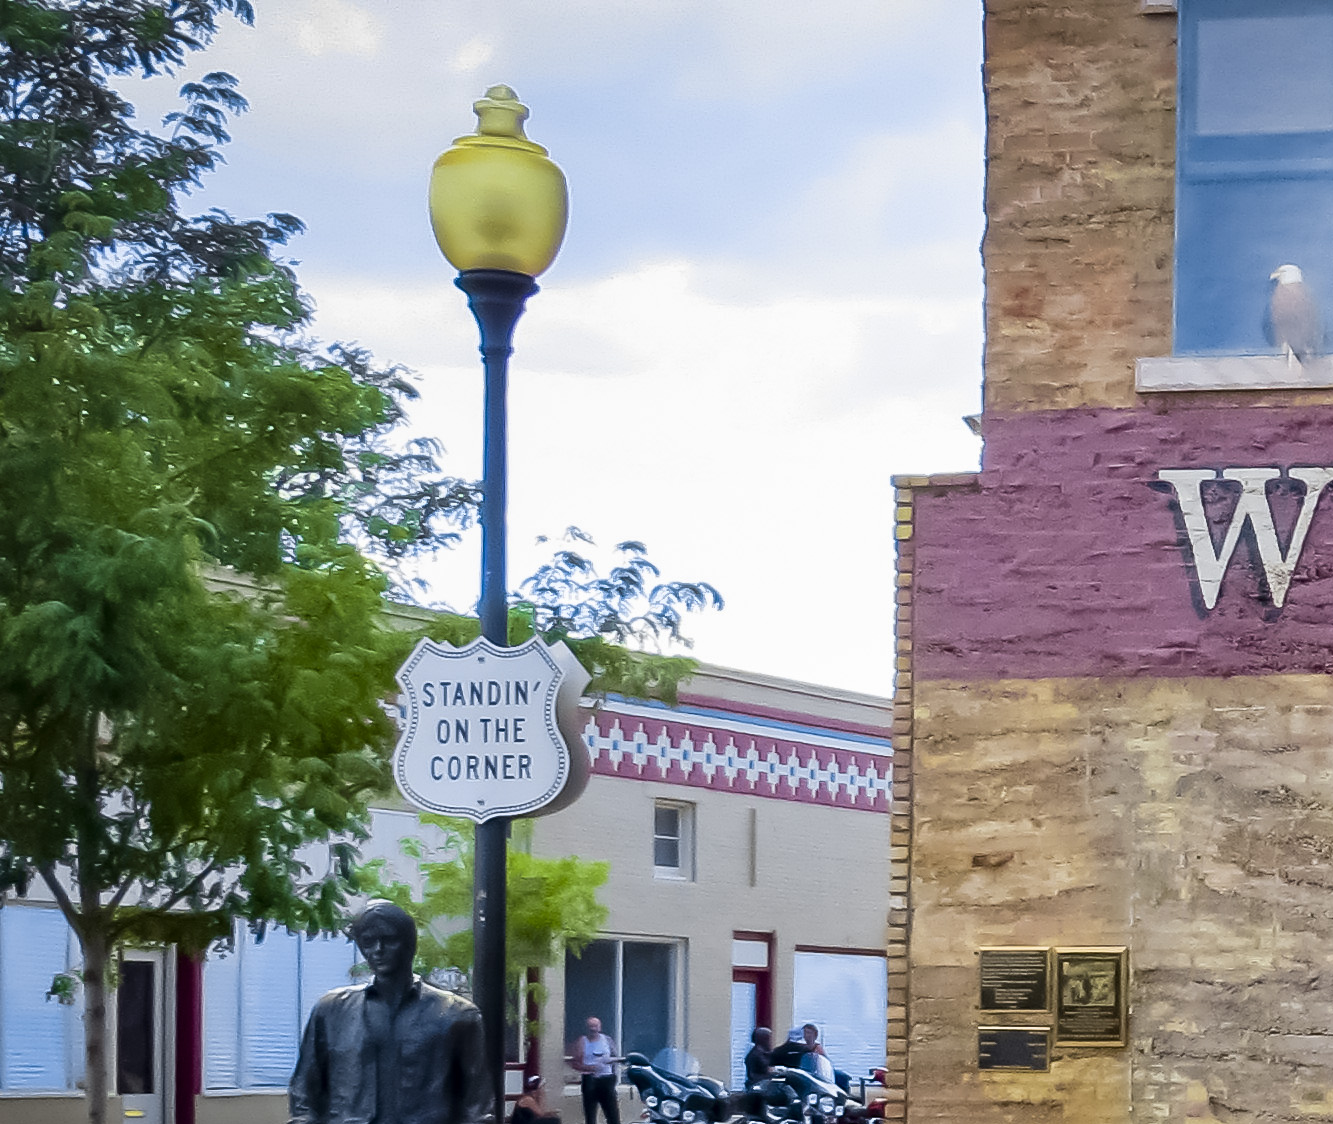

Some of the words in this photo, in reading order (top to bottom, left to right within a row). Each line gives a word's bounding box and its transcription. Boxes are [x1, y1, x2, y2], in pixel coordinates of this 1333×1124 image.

[422, 681, 541, 707] STANDIN'
[437, 719, 469, 743] ON
[480, 718, 525, 743] THE
[431, 755, 531, 780] CORNER
